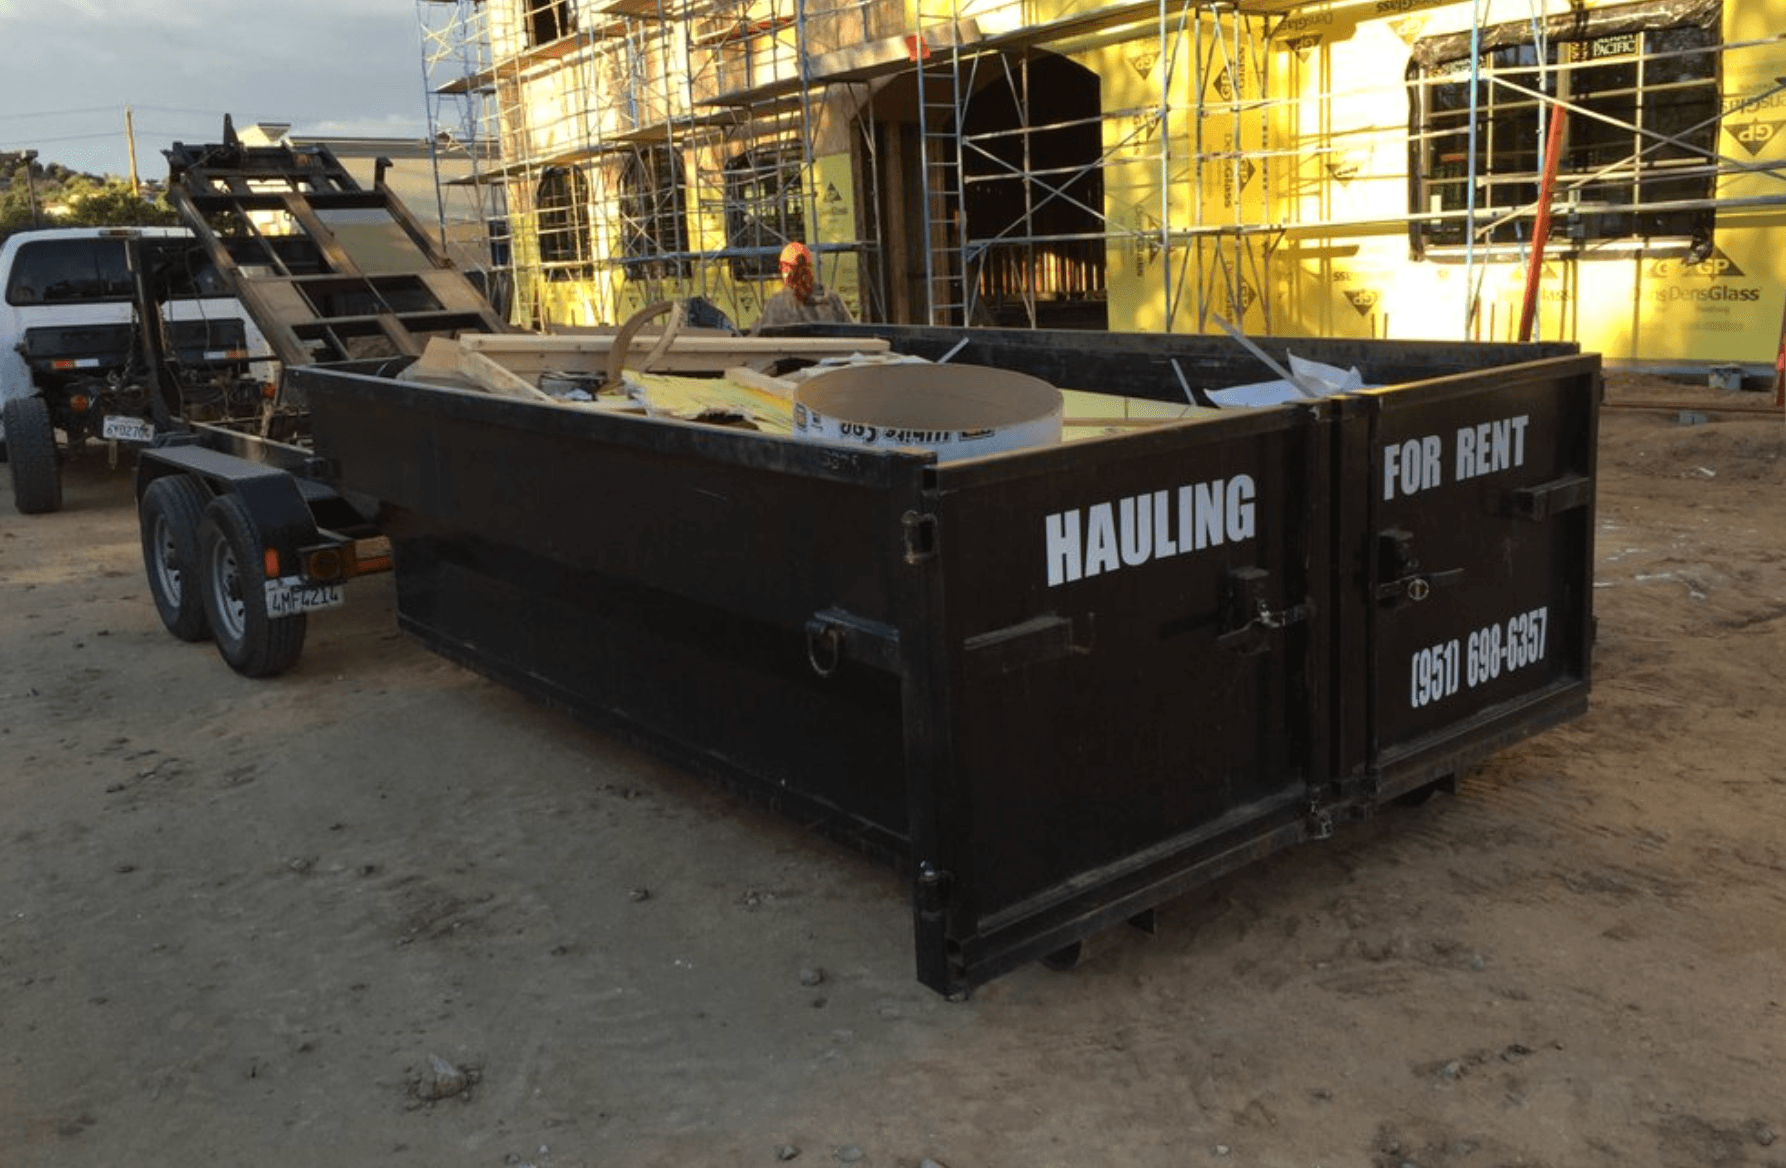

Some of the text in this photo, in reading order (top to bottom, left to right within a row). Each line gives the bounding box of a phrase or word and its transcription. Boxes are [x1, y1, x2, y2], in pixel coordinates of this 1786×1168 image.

[1593, 39, 1636, 57] PACIFIC
[1737, 123, 1774, 142] GP
[1224, 133, 1233, 208] DesGlass
[1695, 258, 1730, 275] GP
[1669, 285, 1760, 302] DensGlass
[1384, 415, 1529, 500] FOR RENT
[1046, 474, 1255, 587] HAULING
[1411, 606, 1548, 708] (951) 698-6357
